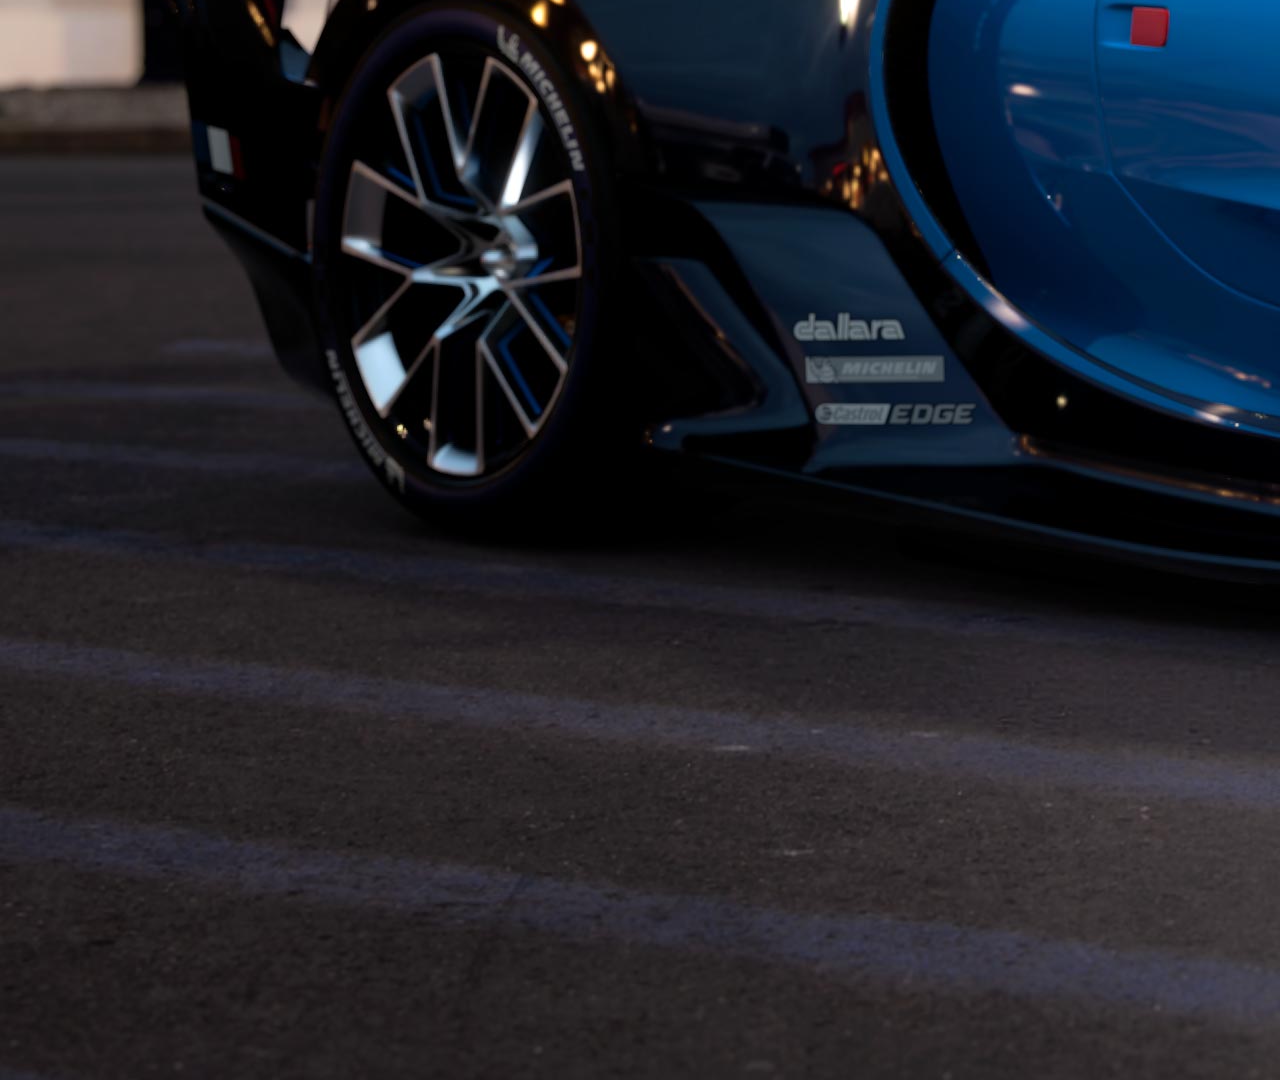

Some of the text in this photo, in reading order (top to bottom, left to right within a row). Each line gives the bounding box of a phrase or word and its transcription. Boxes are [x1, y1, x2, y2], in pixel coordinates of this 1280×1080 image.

[519, 50, 586, 173] MICHELIN
[793, 313, 905, 341] dallara
[841, 359, 938, 375] MICHELIN
[833, 403, 976, 425] Castrol EDGE
